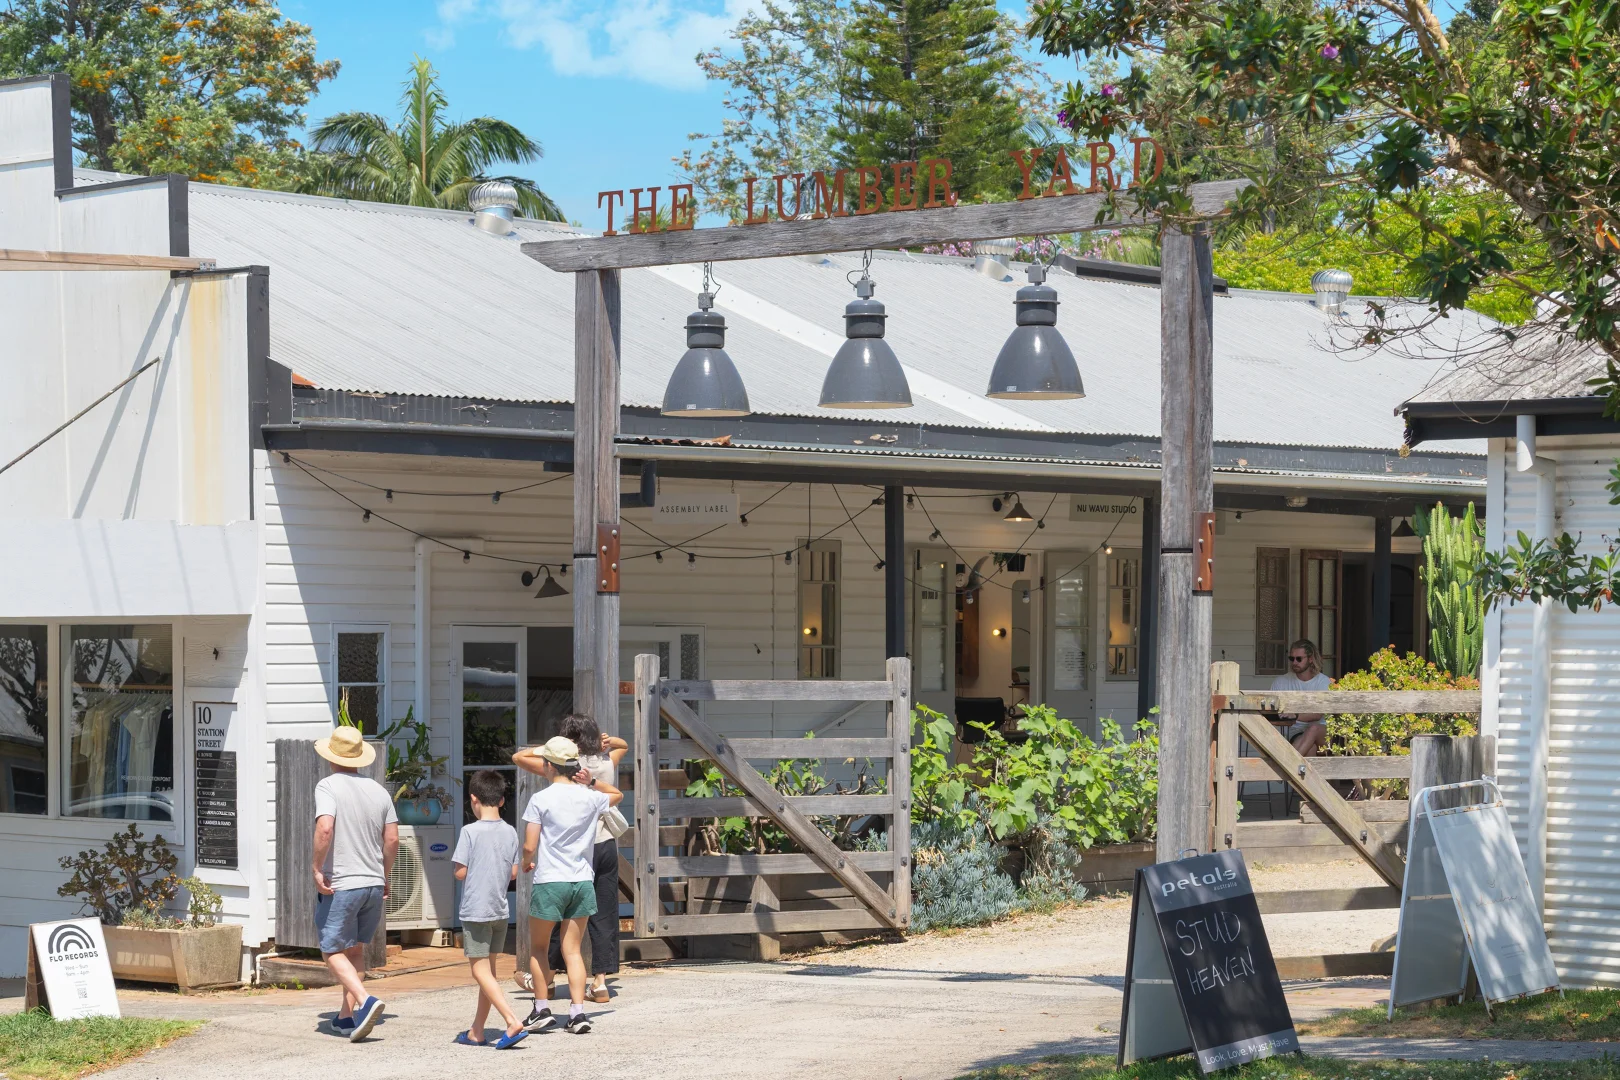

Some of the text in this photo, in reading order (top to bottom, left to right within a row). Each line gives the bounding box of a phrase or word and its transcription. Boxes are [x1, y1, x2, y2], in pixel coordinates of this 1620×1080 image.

[598, 137, 1165, 237] THE LUMBER YARD
[660, 505, 729, 513] ASSEMBLY LABEL
[1076, 504, 1137, 514] NU WAVU STUDIO
[198, 706, 212, 725] 10
[197, 728, 225, 737] STATION
[197, 739, 222, 748] STREET
[1161, 866, 1237, 897] petals
[1213, 881, 1238, 891] australia
[1175, 911, 1241, 956] STUD
[65, 951, 99, 961] RECORDS
[1186, 945, 1256, 996] HEAVEN
[1226, 1047, 1249, 1060] Love.
[1247, 1042, 1269, 1054] Must
[1268, 1037, 1290, 1049] Have
